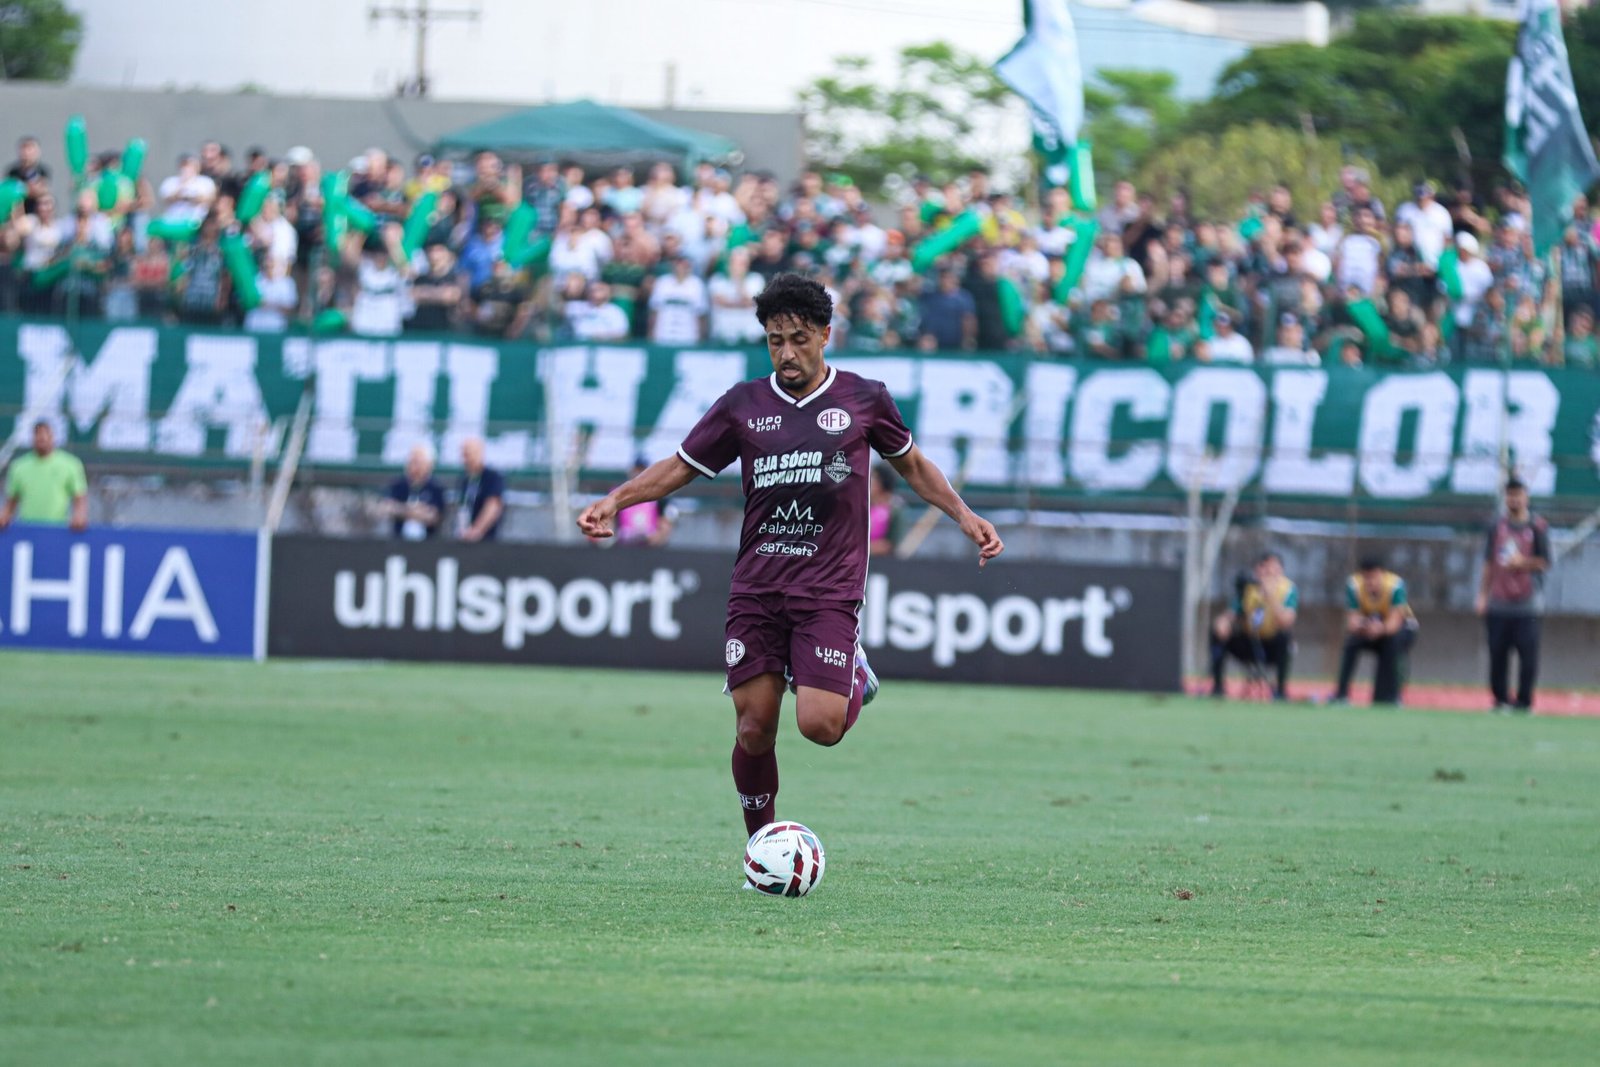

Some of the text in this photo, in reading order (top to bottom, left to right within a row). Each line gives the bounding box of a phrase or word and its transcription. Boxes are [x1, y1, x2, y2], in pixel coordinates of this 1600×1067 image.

[11, 323, 748, 476] MATILHA
[748, 415, 782, 429] LUPO
[820, 411, 846, 428] AFE
[756, 423, 782, 433] SPORT
[753, 449, 823, 475] SEJA SÓCIO
[758, 522, 824, 537] BaladAPP
[760, 543, 813, 557] GBTickets
[0, 540, 220, 643] HIA
[332, 556, 682, 650] uhlsport
[860, 573, 1115, 668] lsport
[815, 646, 847, 662] LUPO
[823, 657, 847, 669] SPORT
